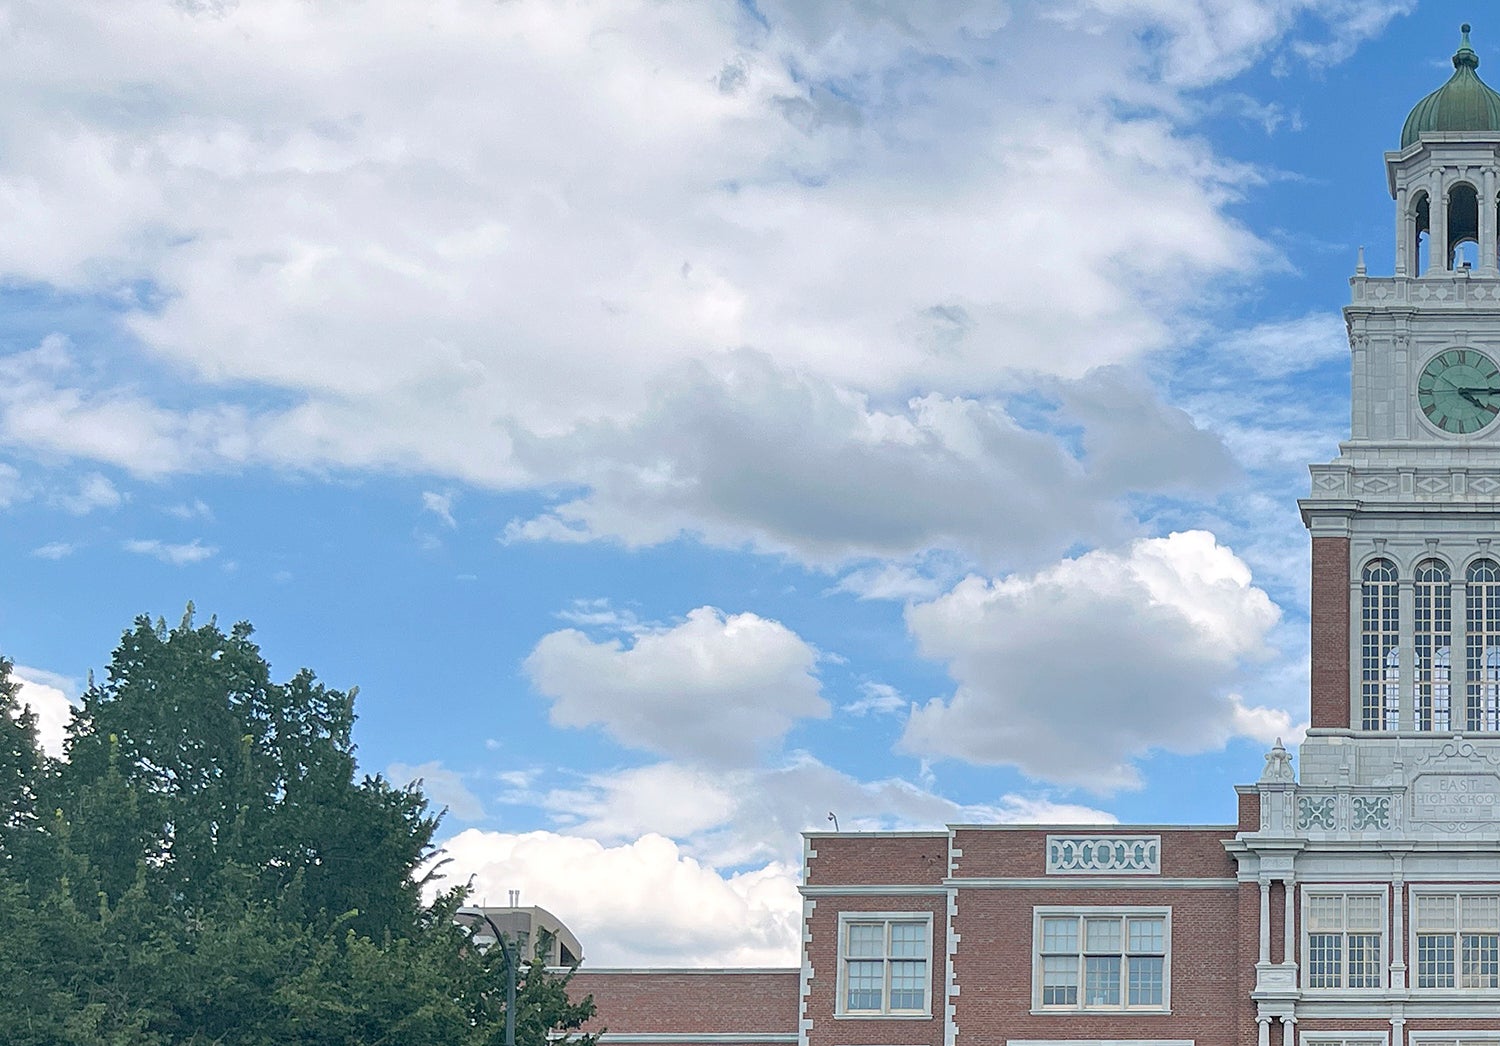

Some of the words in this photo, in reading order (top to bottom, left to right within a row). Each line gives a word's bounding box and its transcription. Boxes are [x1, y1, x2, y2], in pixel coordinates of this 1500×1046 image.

[1440, 779, 1478, 791] EAST
[1416, 794, 1447, 804] HIGH
[1453, 794, 1499, 804] SCHOOL
